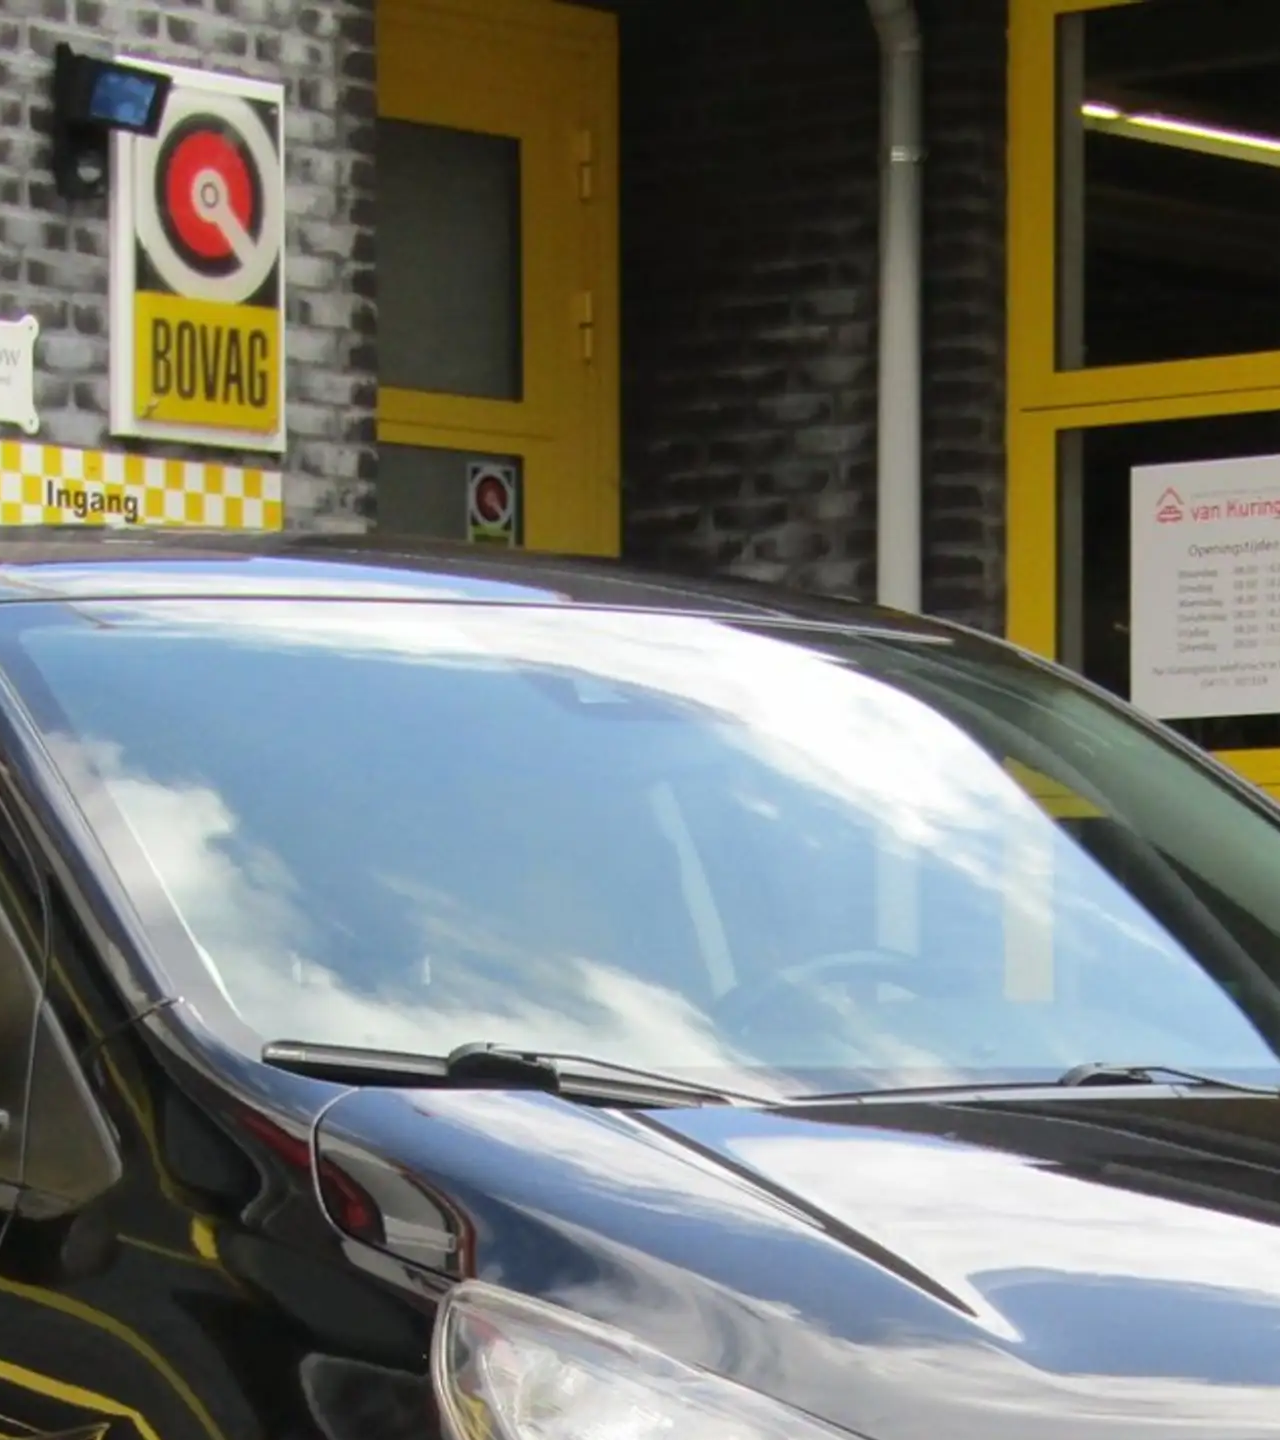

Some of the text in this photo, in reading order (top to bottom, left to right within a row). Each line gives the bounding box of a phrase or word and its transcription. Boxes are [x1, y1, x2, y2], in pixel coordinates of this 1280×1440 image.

[152, 317, 268, 409] BOVAG
[47, 479, 138, 524] Ingang
[1190, 505, 1221, 521] van
